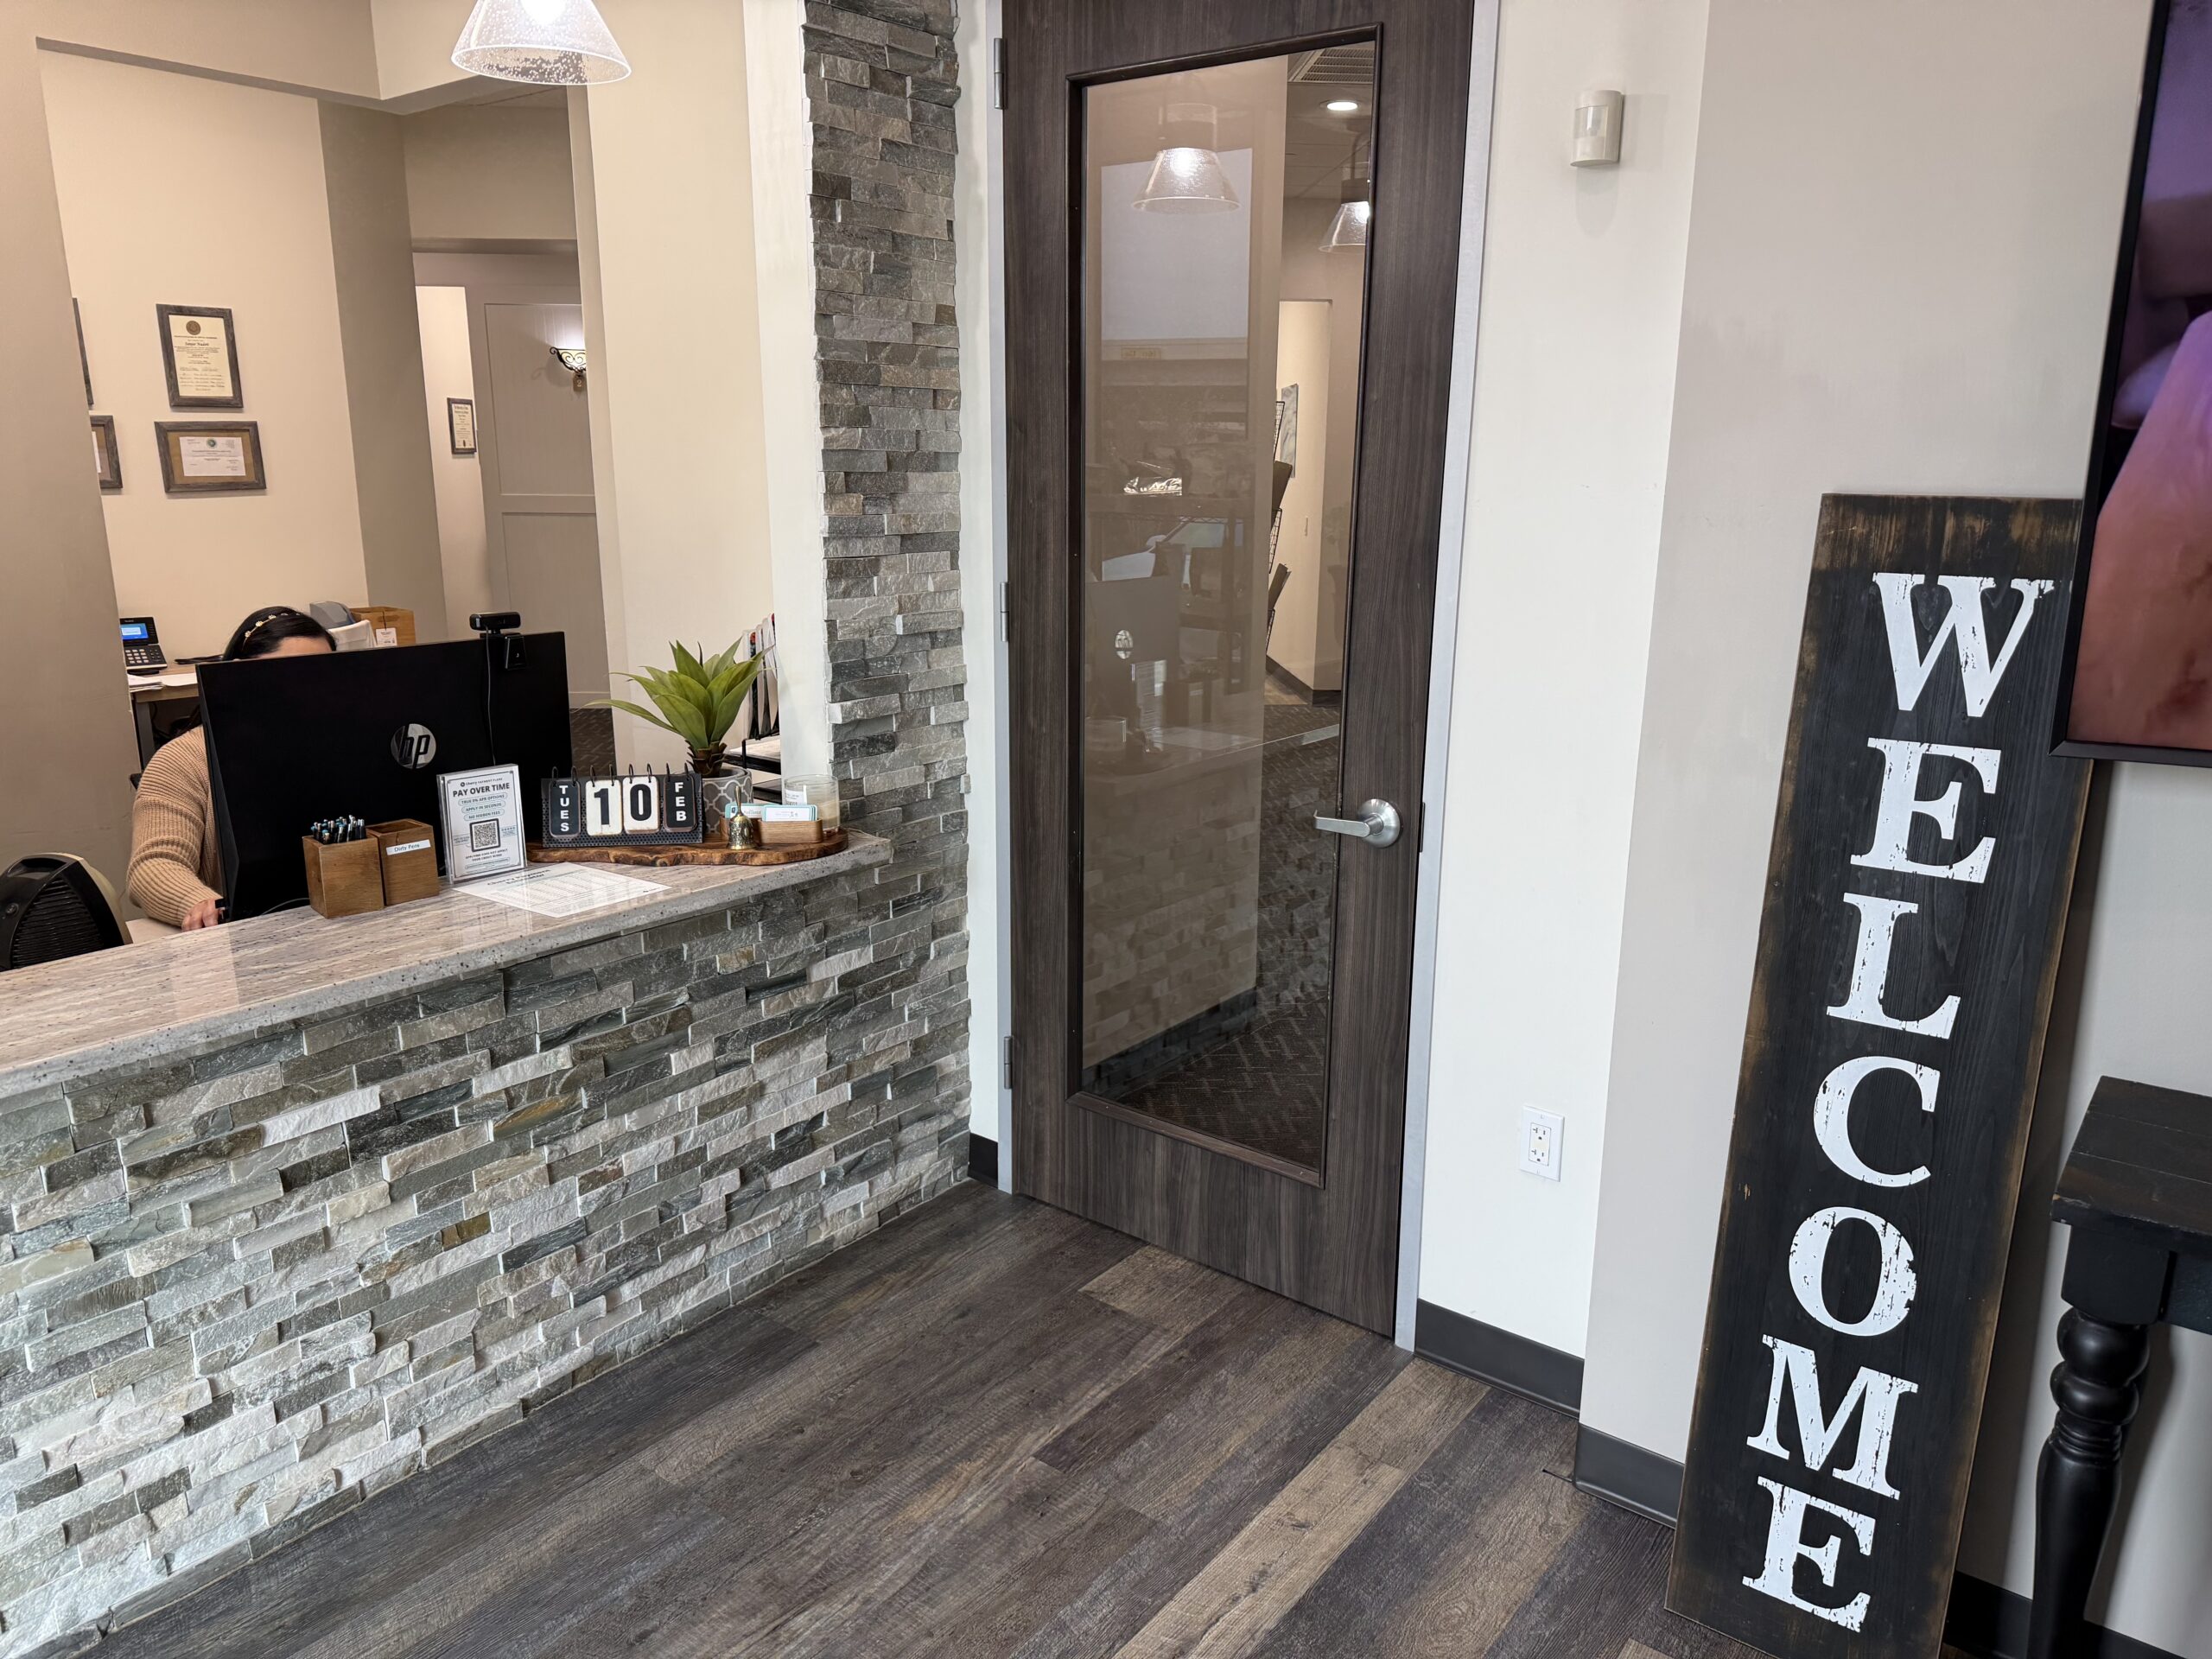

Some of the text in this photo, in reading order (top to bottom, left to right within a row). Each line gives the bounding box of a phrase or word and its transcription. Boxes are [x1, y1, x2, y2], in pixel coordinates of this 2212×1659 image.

[397, 723, 431, 770] hp
[470, 785, 491, 795] OVER
[492, 782, 510, 791] TIME
[558, 785, 570, 832] TUES
[674, 782, 687, 821] FEB
[1741, 572, 2055, 1632] WELCOME
